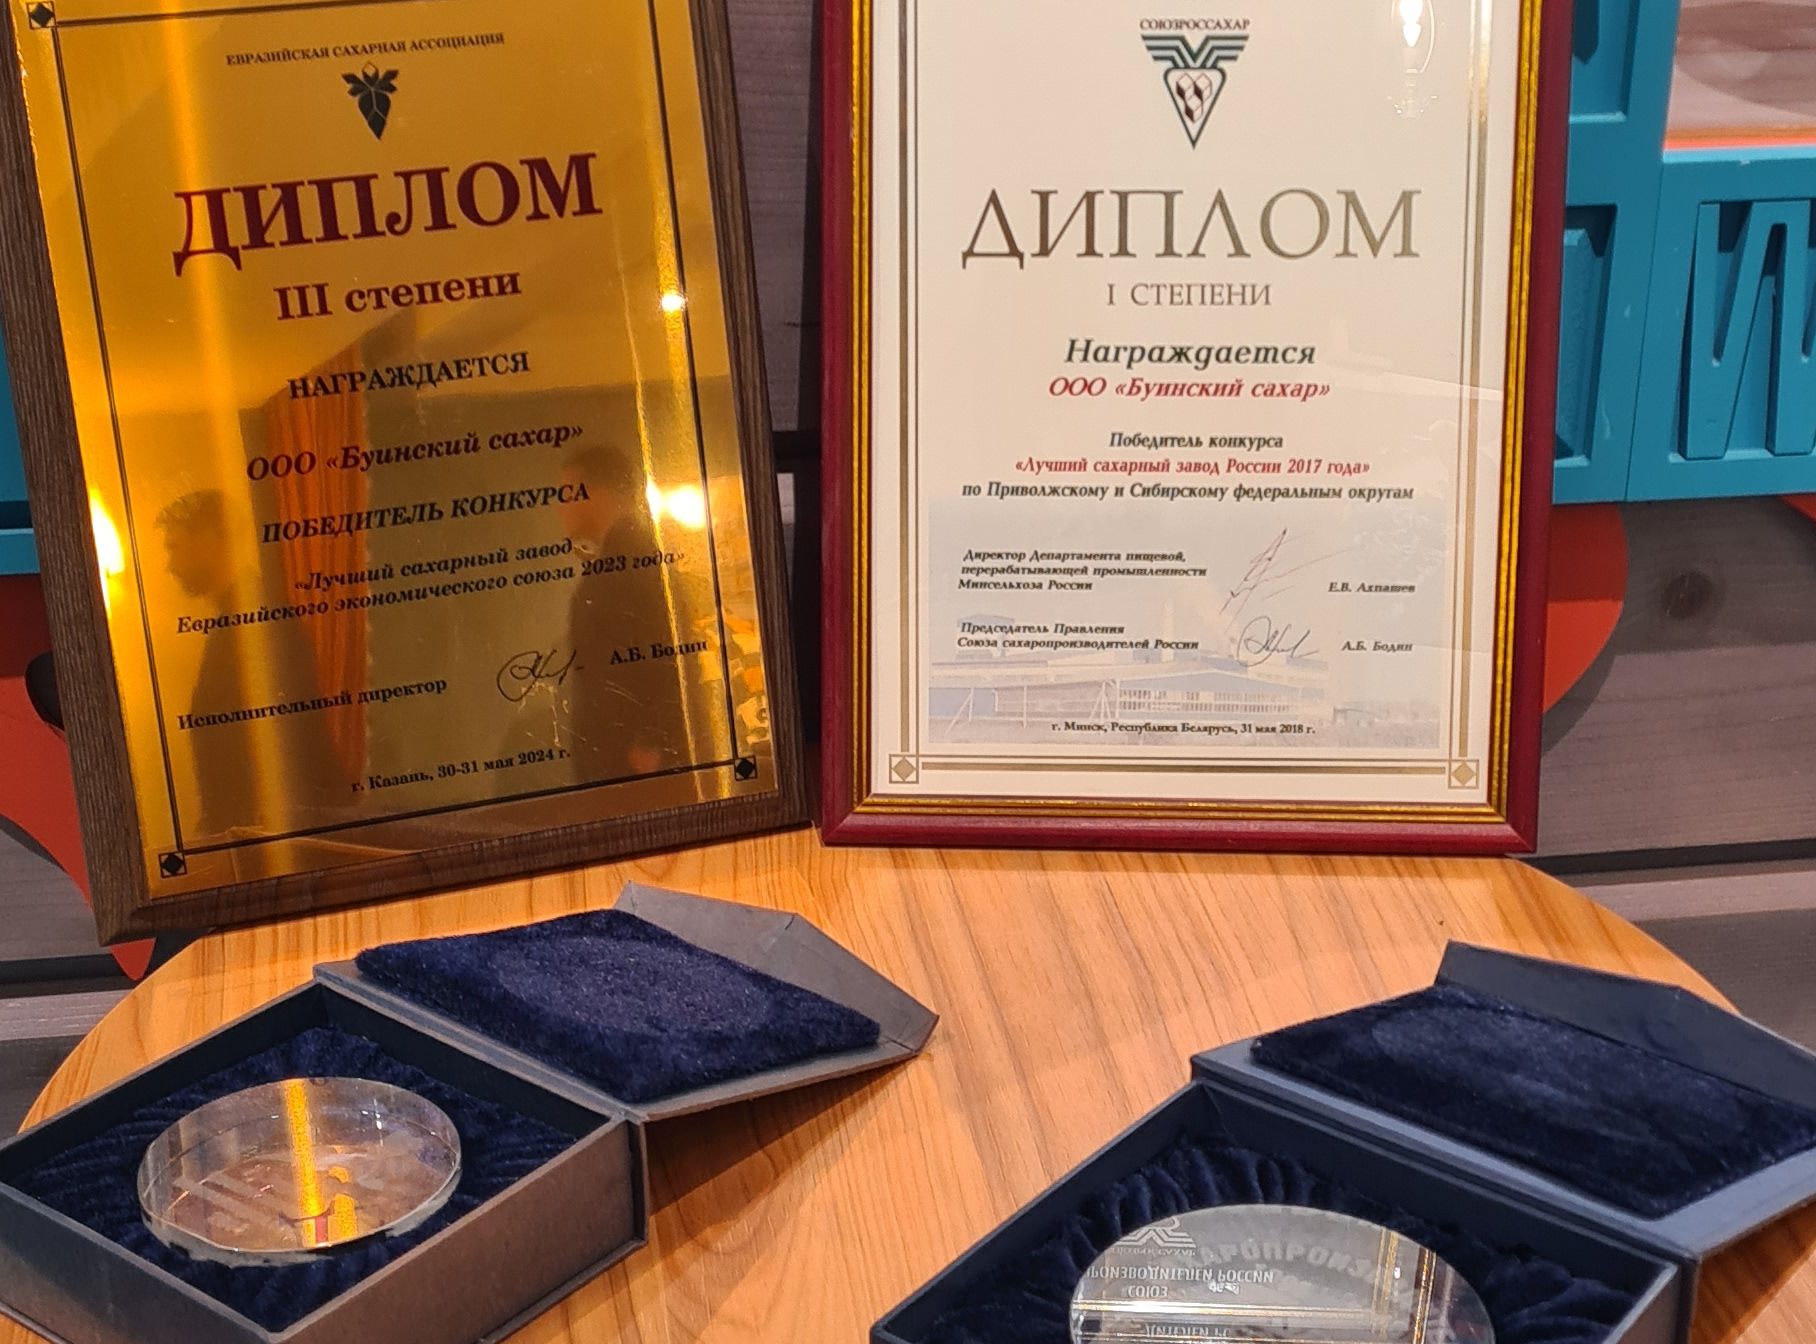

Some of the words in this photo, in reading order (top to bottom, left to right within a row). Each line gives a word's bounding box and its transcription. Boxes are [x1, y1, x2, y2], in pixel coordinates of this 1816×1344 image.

[1139, 19, 1250, 31] СОЮЗРОССАХАР
[226, 47, 330, 66] ЕВРАЗИЙСКАЯ
[333, 41, 406, 58] САХАРНАЯ
[409, 32, 504, 52] АССОЦИАЦИЯ
[172, 152, 603, 276] ДИПЛОМ
[961, 188, 1422, 269] ДИПЛОМ
[274, 284, 332, 320] III
[345, 271, 521, 316] степени
[1130, 283, 1271, 307] СТЕПЕНИ
[1064, 338, 1316, 371] Награждается
[288, 351, 530, 400] НАГРАЖДАЕТСЯ
[1049, 377, 1107, 397] ООО
[1115, 378, 1244, 401] «Буинский
[1250, 383, 1331, 402] сахар»
[246, 450, 316, 481] ООО
[326, 432, 480, 473] «Буинский
[489, 423, 584, 451] сахар»
[1108, 432, 1203, 450] Победитель
[1209, 435, 1284, 451] конкурса
[1015, 457, 1088, 475] «Лучший
[1093, 458, 1171, 475] сахарный
[1176, 461, 1221, 476] завод
[1226, 458, 1282, 474] России
[1287, 458, 1322, 475] 2017
[1327, 462, 1370, 477] года»
[961, 484, 981, 497] по
[987, 481, 1109, 500] Приволжскому
[1114, 485, 1125, 498] и
[1130, 482, 1229, 501] Сибирскому
[1233, 482, 1342, 501] федеральным
[1348, 485, 1415, 502] округам
[261, 503, 444, 544] ПОБЕДИТЕЛЬ
[450, 483, 590, 519] КОНКУРСА
[295, 563, 394, 591] «Лучший
[401, 547, 508, 576] сахарный
[515, 538, 573, 561] завод
[963, 549, 1027, 563] Директор
[1029, 549, 1121, 563] Департамента
[1126, 550, 1186, 563] пищевой,
[961, 564, 1088, 577] перерабатывающей
[1093, 565, 1208, 578] промышленности
[176, 600, 329, 634] Евразийского
[334, 577, 508, 613] экономического
[514, 567, 574, 587] союза
[582, 555, 627, 576] 2023
[958, 579, 1043, 590] Минсельхоза
[1048, 579, 1093, 591] России
[1328, 581, 1352, 594] Е.В.
[961, 622, 1049, 635] Председатель
[1053, 623, 1125, 635] Правления
[610, 646, 646, 665] А.Б.
[957, 636, 998, 649] Союза
[1002, 637, 1149, 651] сахаропроизводителей
[1153, 638, 1199, 650] России
[1341, 640, 1367, 652] А.Б.
[1372, 640, 1413, 653] Бодин
[178, 692, 352, 730] Исполнительный
[357, 678, 448, 704] директор
[1052, 723, 1062, 732] г.
[1064, 722, 1108, 733] Минск,
[1111, 722, 1178, 734] Республика
[1181, 723, 1238, 735] Беларусь,
[1240, 724, 1252, 734] 31
[1255, 725, 1277, 734] мая
[1279, 724, 1304, 734] 2018
[1307, 725, 1316, 735] г.
[351, 781, 365, 793] г.
[369, 771, 434, 790] Казань,
[438, 761, 478, 779] 30-31
[484, 757, 514, 771] мая
[518, 748, 554, 765] 2024
[559, 748, 571, 760] г.
